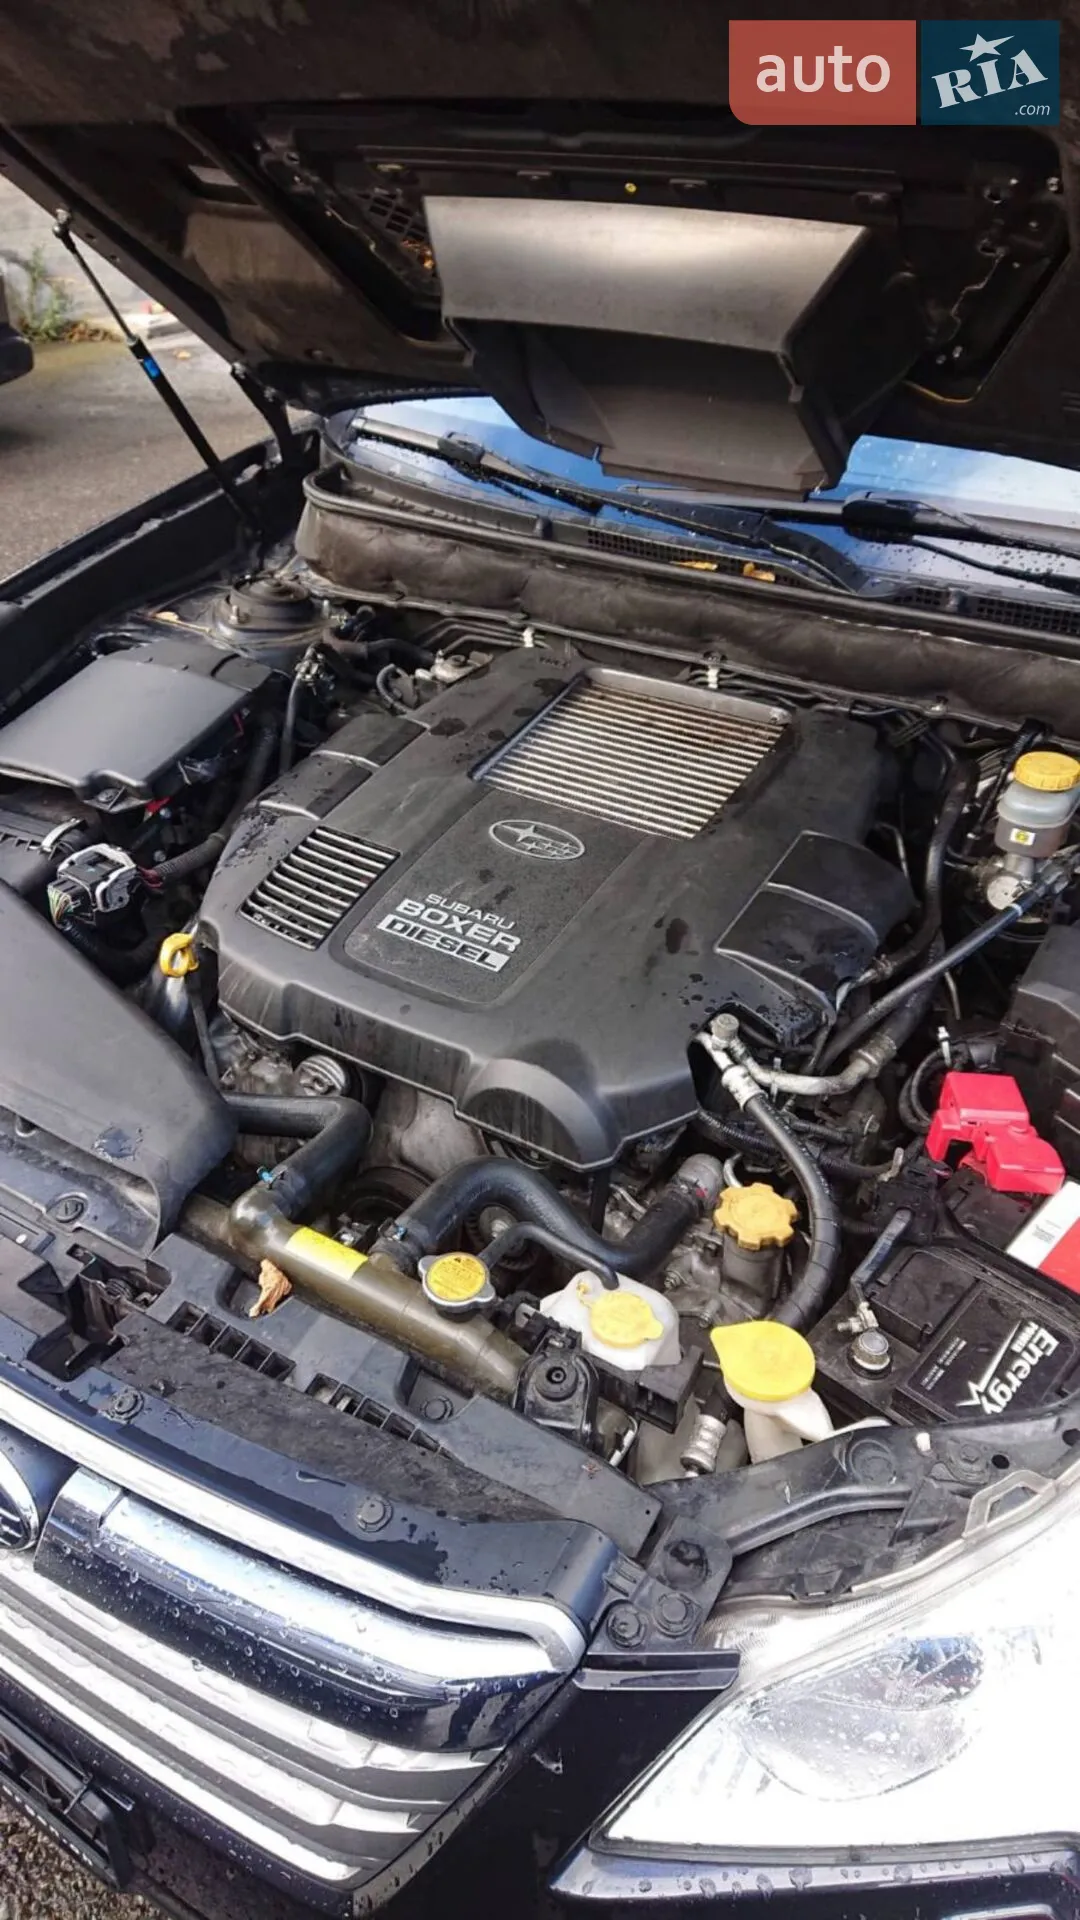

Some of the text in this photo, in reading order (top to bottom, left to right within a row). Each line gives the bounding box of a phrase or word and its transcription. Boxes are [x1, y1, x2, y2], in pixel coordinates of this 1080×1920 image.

[395, 898, 521, 952] BOXER
[425, 893, 515, 929] SUBARU
[385, 918, 498, 969] DIESEL
[981, 1327, 1060, 1414] Energy
